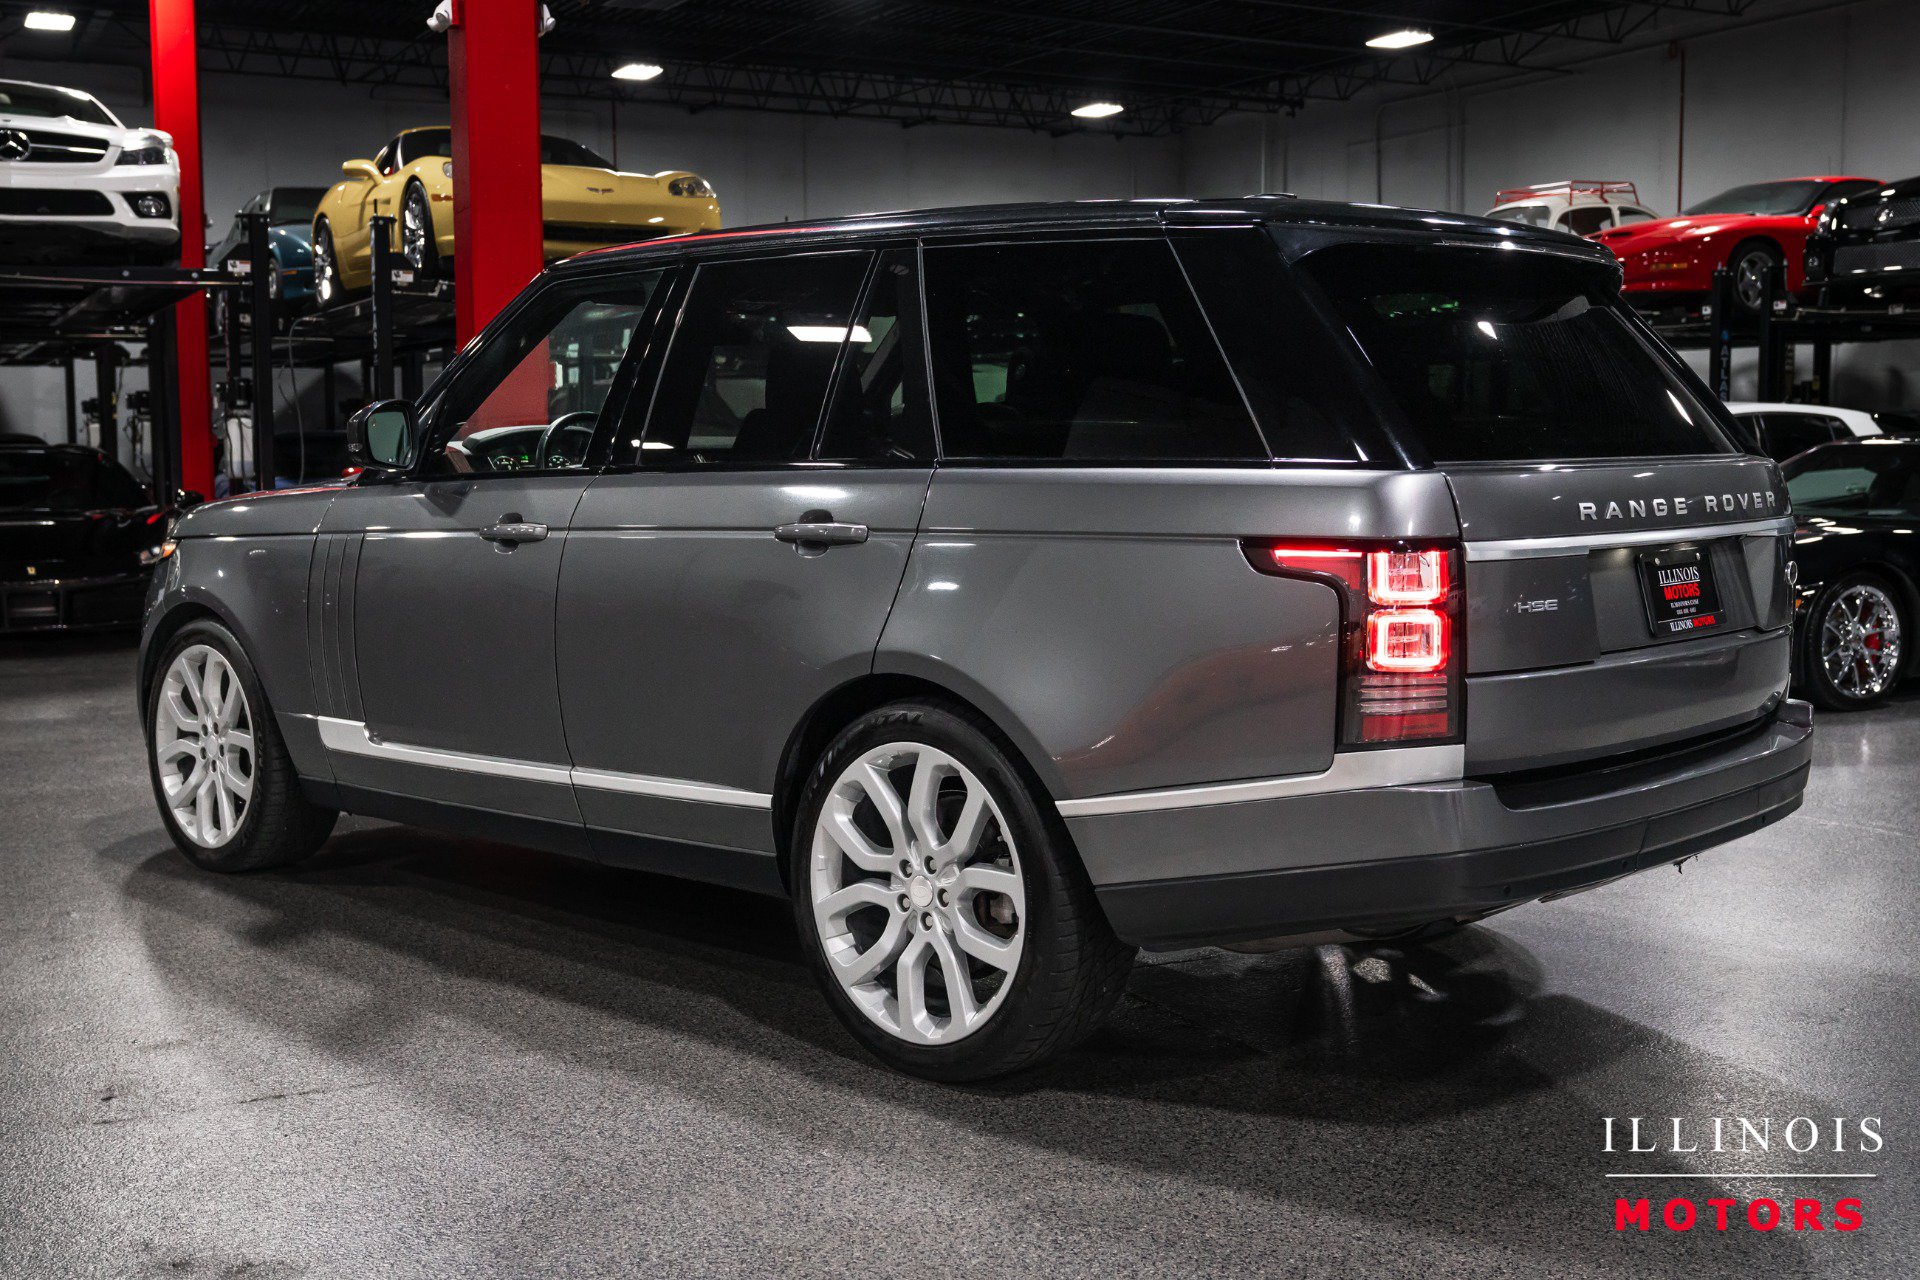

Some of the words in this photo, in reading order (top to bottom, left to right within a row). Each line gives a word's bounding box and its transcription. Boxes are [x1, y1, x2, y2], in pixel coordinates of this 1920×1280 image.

[1579, 497, 1688, 520] RANGE
[1704, 491, 1776, 512] ROVER
[1658, 566, 1699, 584] ILLINOIS
[1663, 583, 1700, 600] MOTORS
[1517, 599, 1558, 613] HSE
[1670, 619, 1693, 631] ILLINOIS
[1693, 615, 1715, 627] MOTORS
